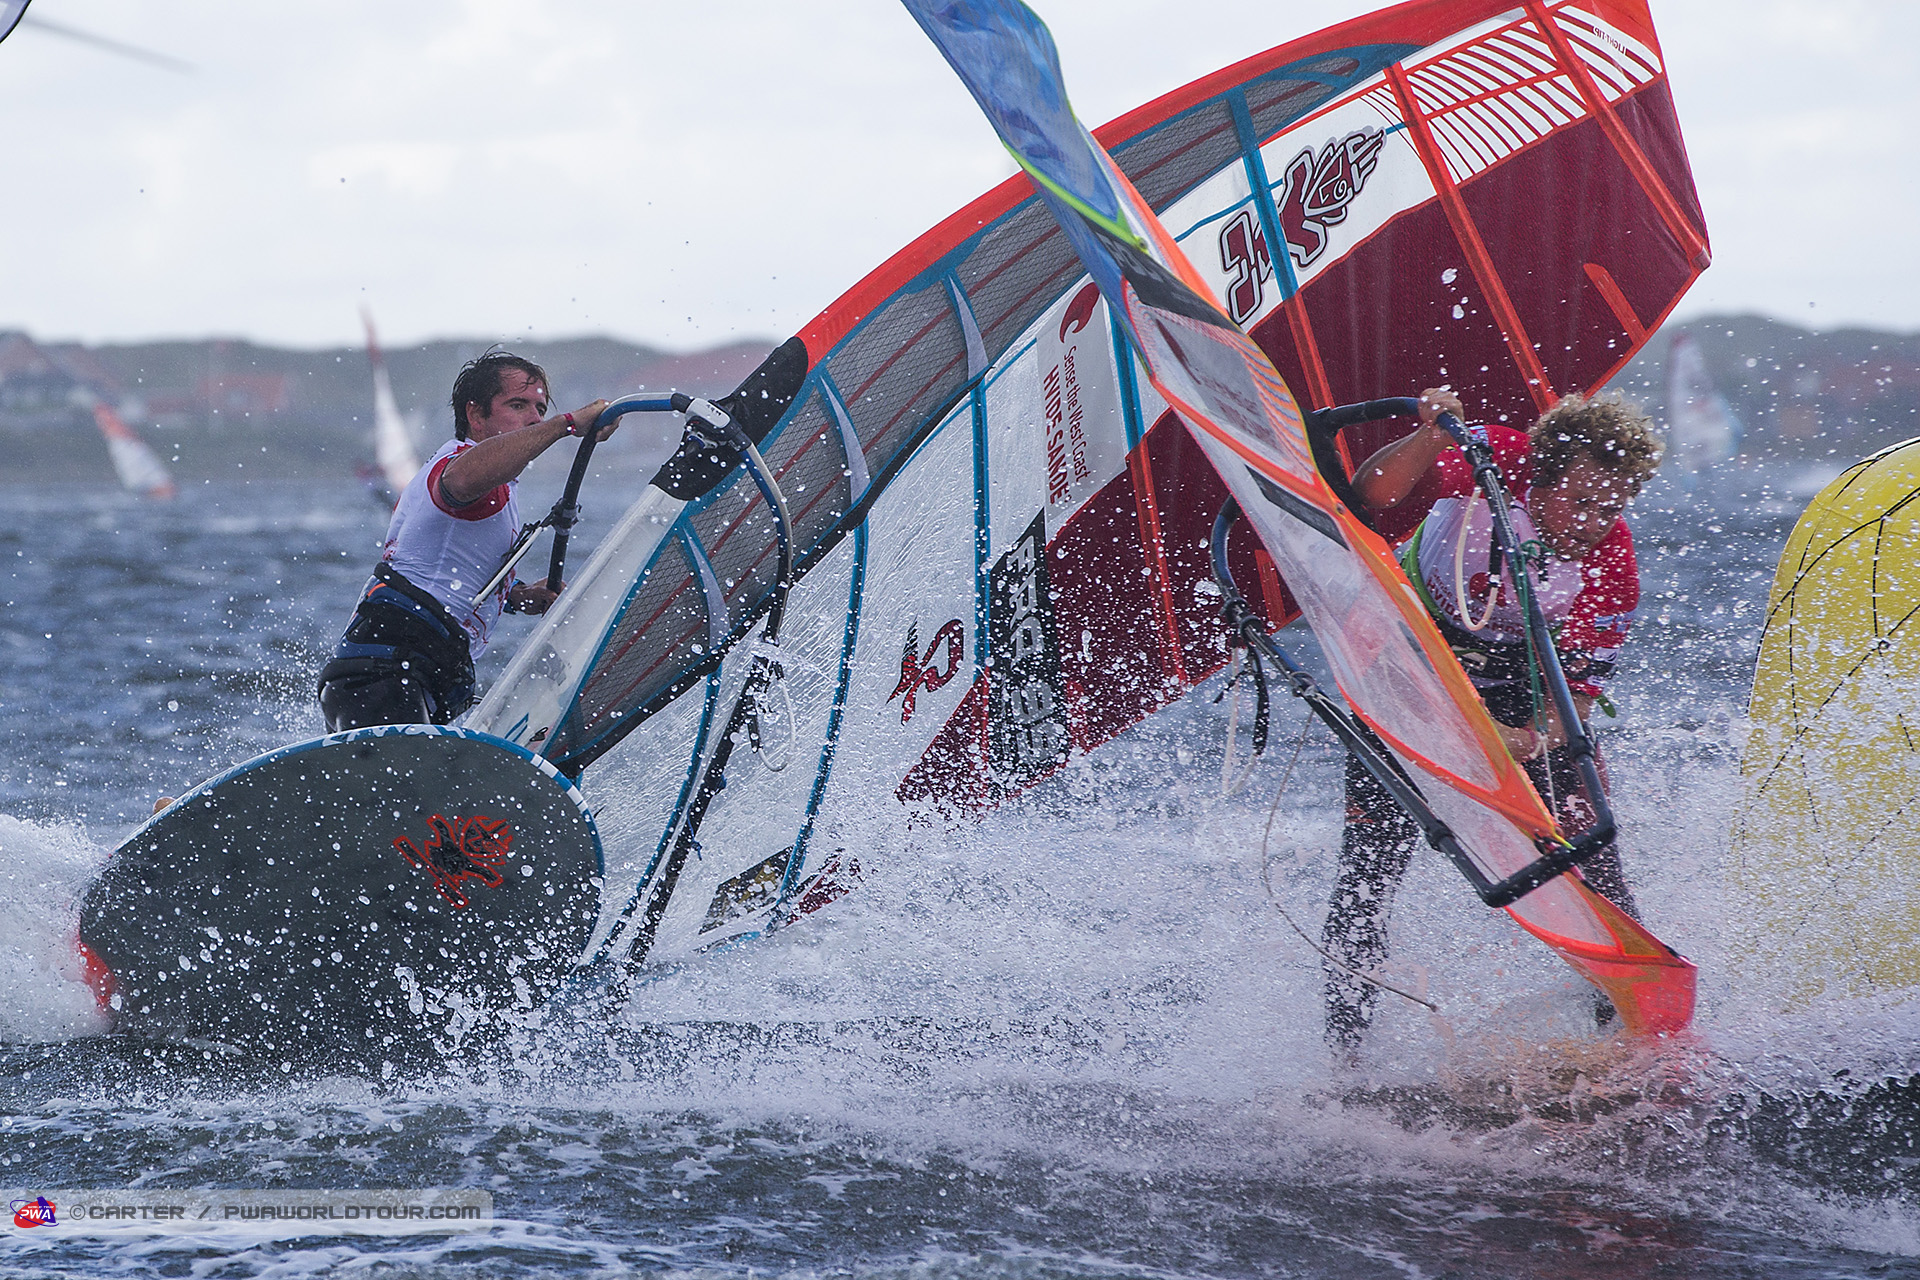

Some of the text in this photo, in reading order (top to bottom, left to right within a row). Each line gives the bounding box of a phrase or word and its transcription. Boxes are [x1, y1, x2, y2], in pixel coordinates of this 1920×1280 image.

[1043, 364, 1070, 504] HVIDE SANDE
[1063, 345, 1091, 482] Sense the West Coast
[1006, 535, 1045, 669] FRA
